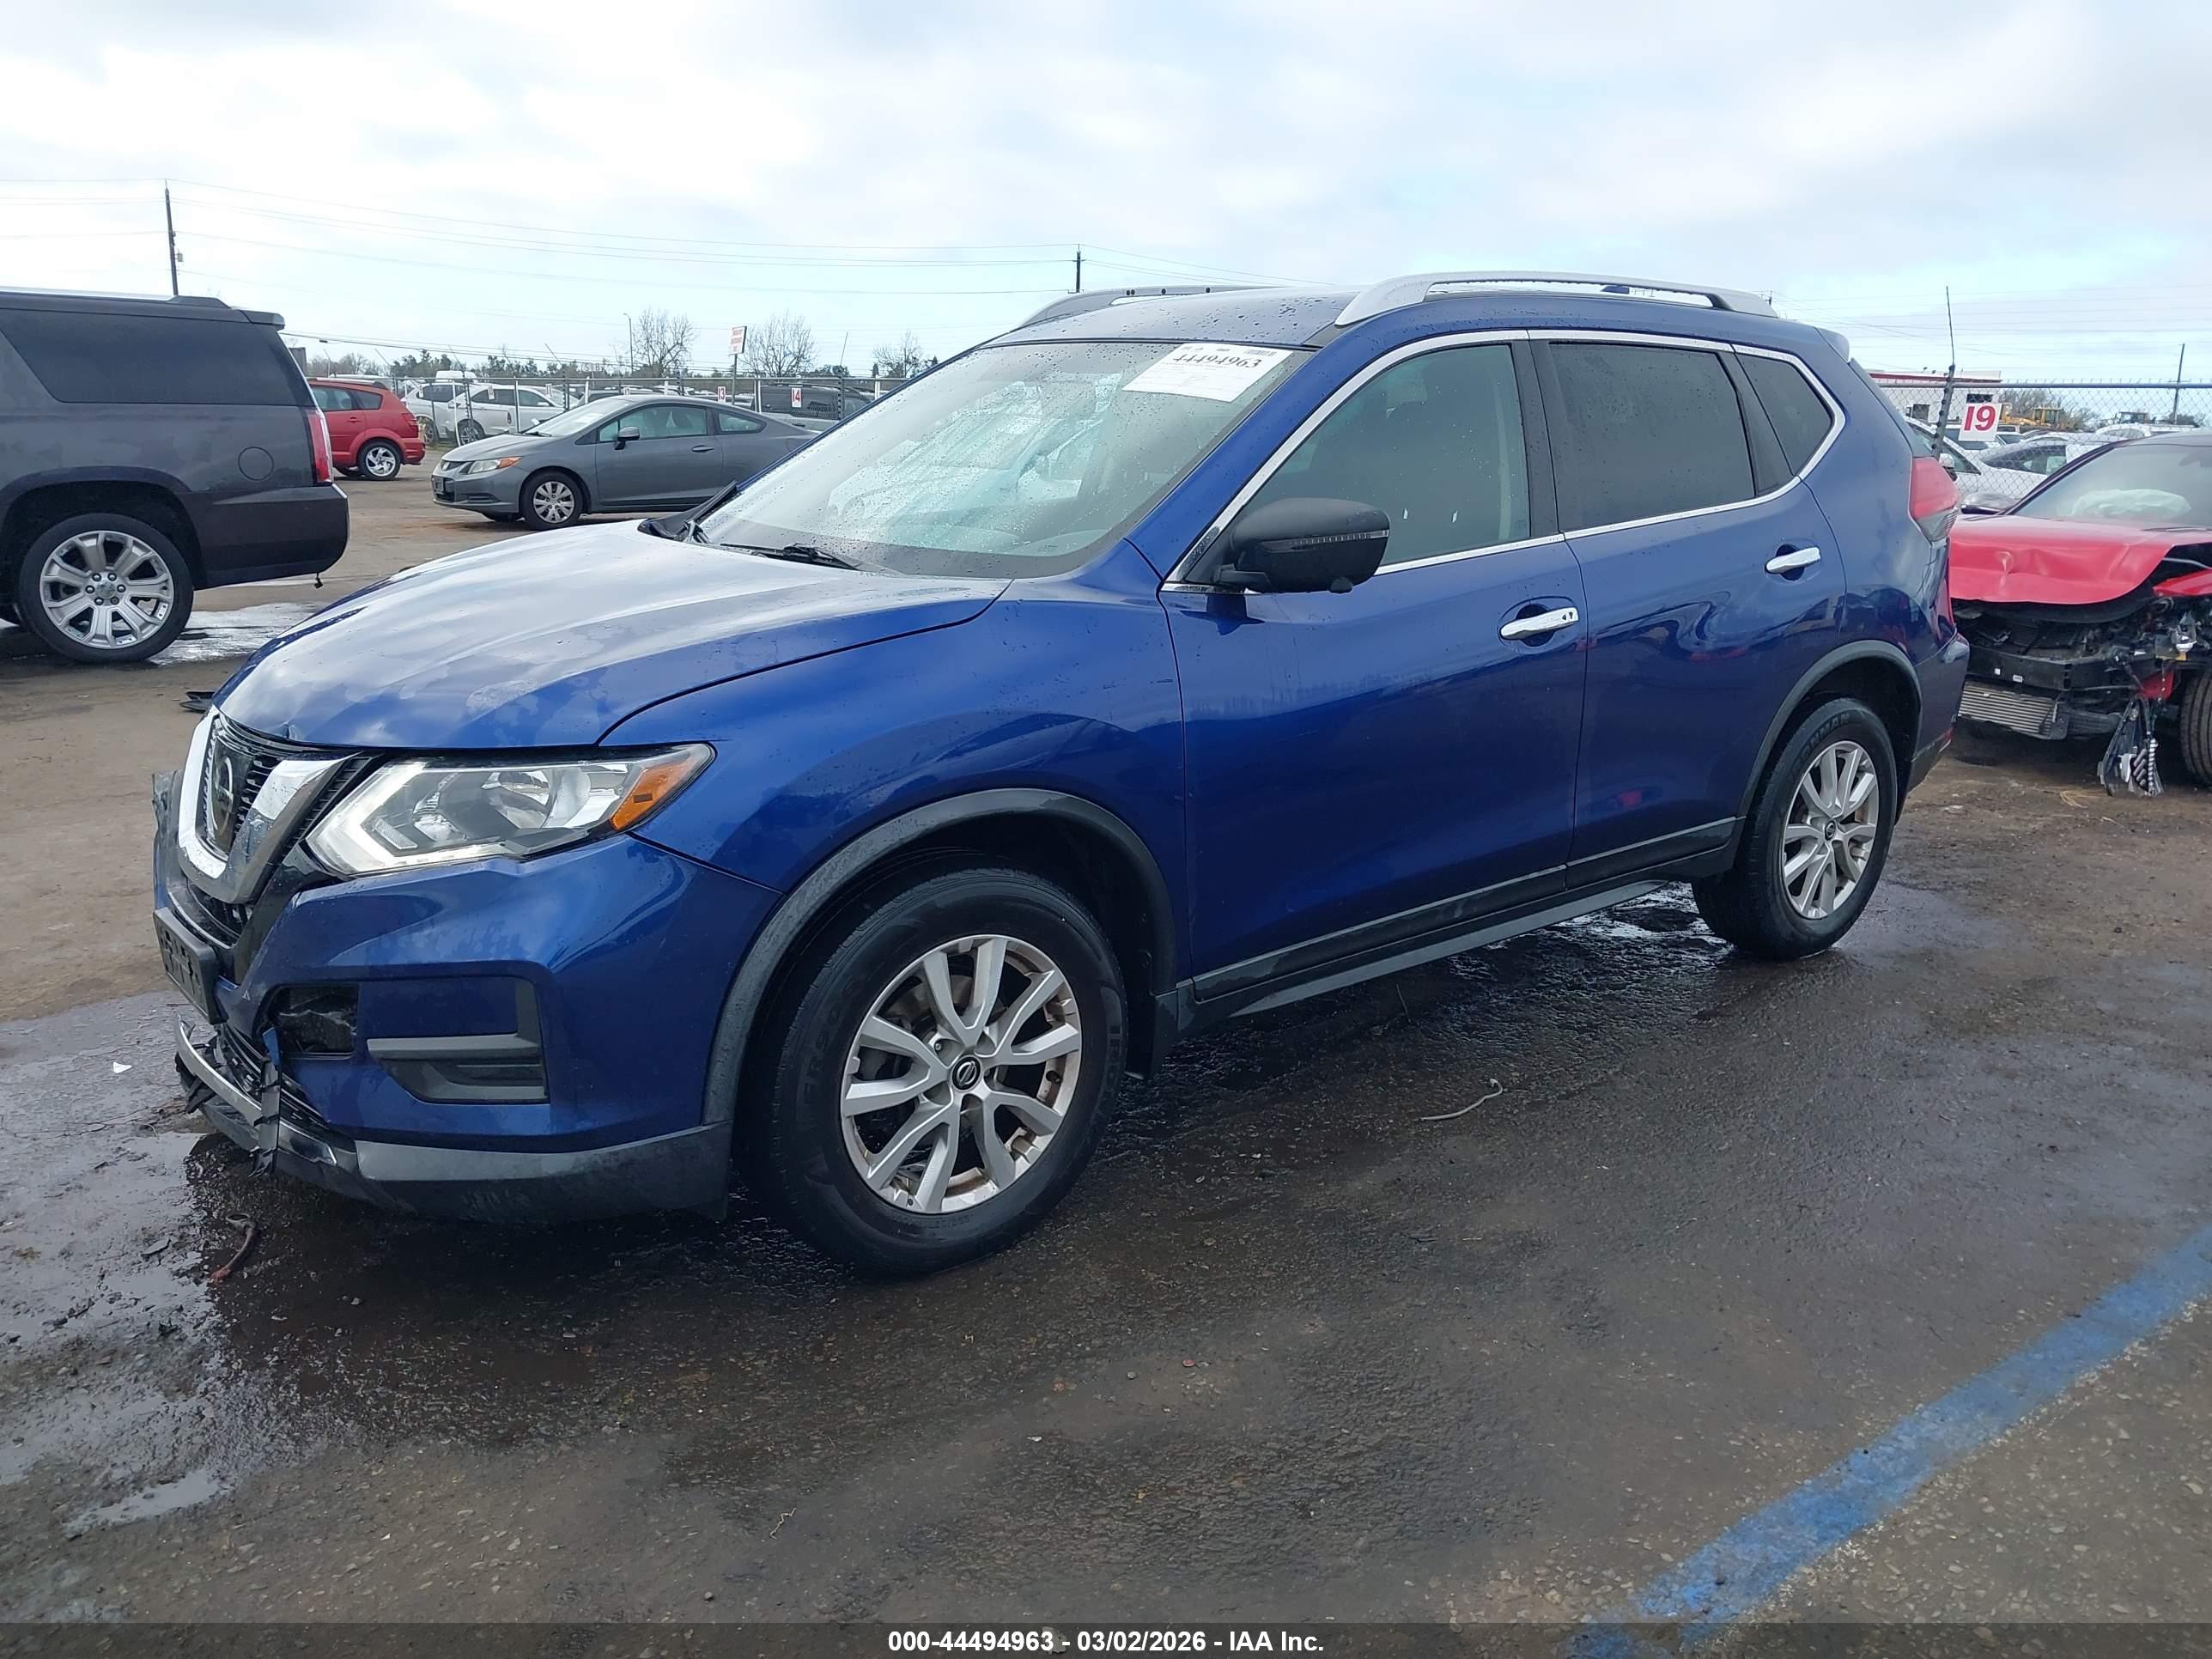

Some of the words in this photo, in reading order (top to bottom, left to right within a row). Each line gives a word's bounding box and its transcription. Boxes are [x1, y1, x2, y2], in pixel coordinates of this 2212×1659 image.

[1173, 354, 1262, 368] 44494963
[793, 389, 801, 403] 14
[1964, 405, 1996, 431] 19
